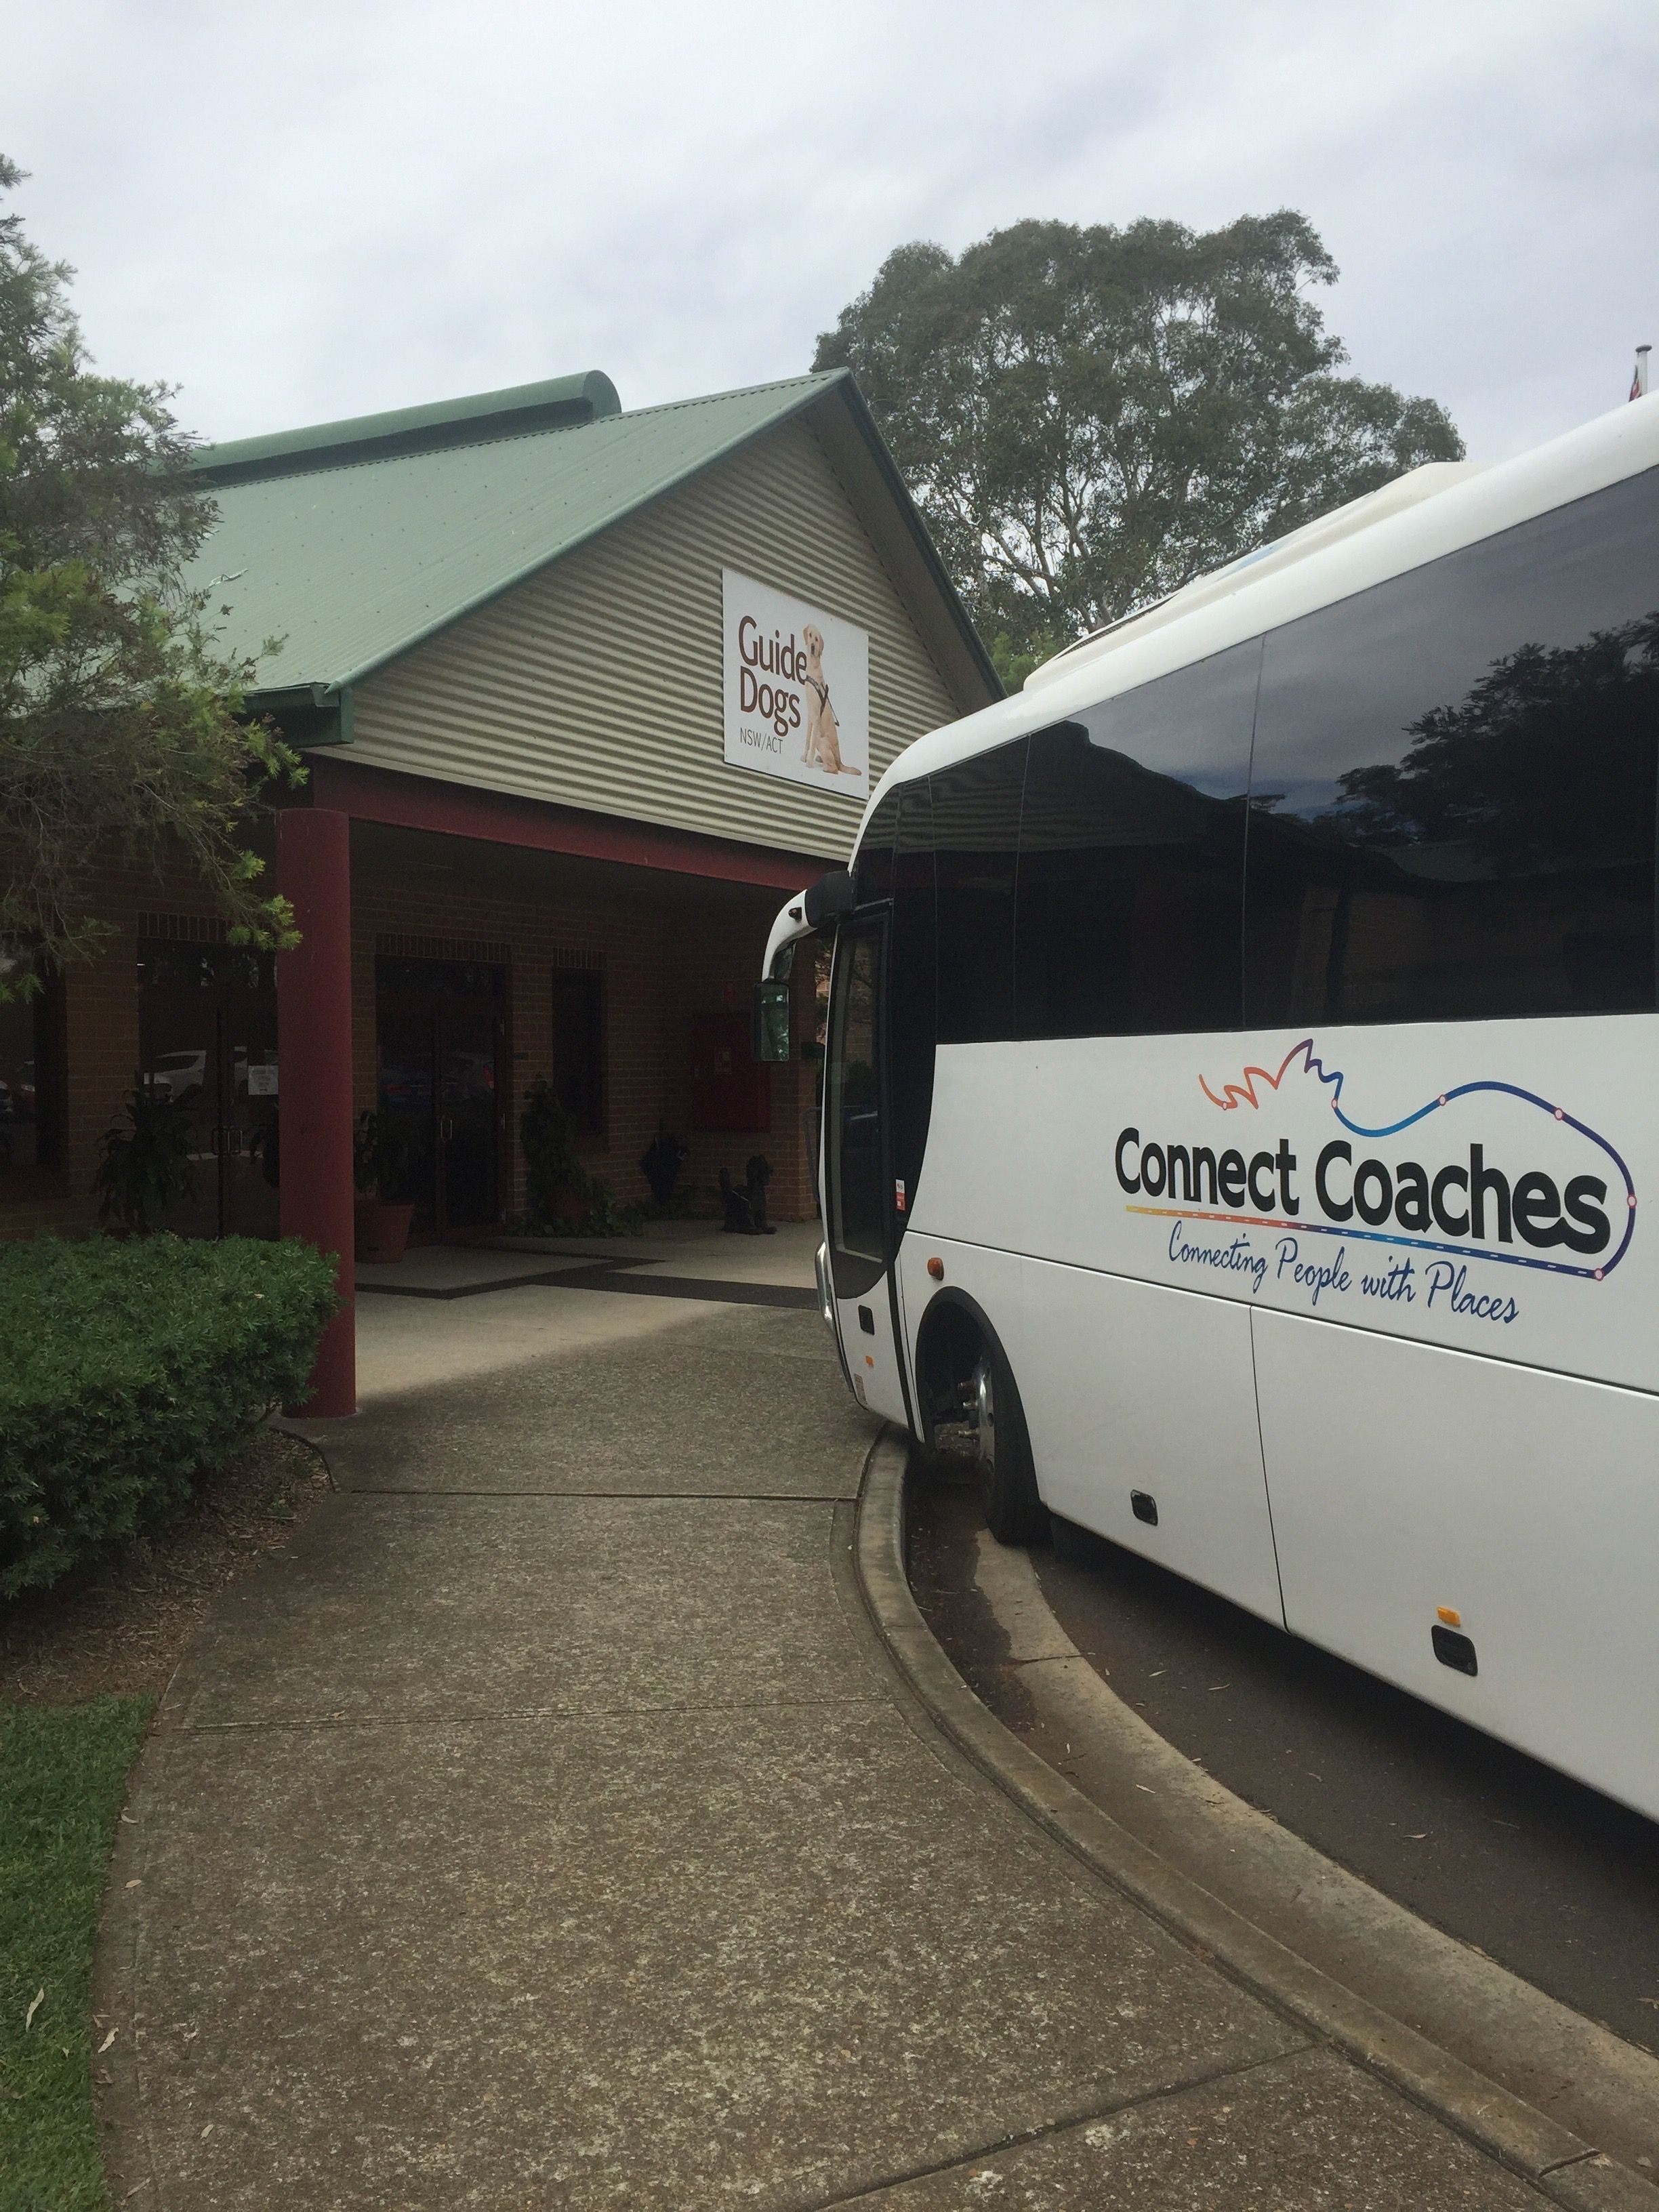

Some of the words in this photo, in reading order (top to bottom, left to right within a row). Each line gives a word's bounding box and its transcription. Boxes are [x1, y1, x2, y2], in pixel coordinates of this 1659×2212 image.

[739, 615, 807, 684] Guide
[740, 666, 801, 737] Dogs
[740, 727, 783, 754] NSW/ACT
[1115, 1127, 1300, 1216] Connect
[1315, 1139, 1612, 1254] Coaches
[1168, 1220, 1269, 1292] Connecting
[1275, 1237, 1353, 1306] People
[1360, 1255, 1418, 1304] with
[1425, 1261, 1520, 1325] Places
